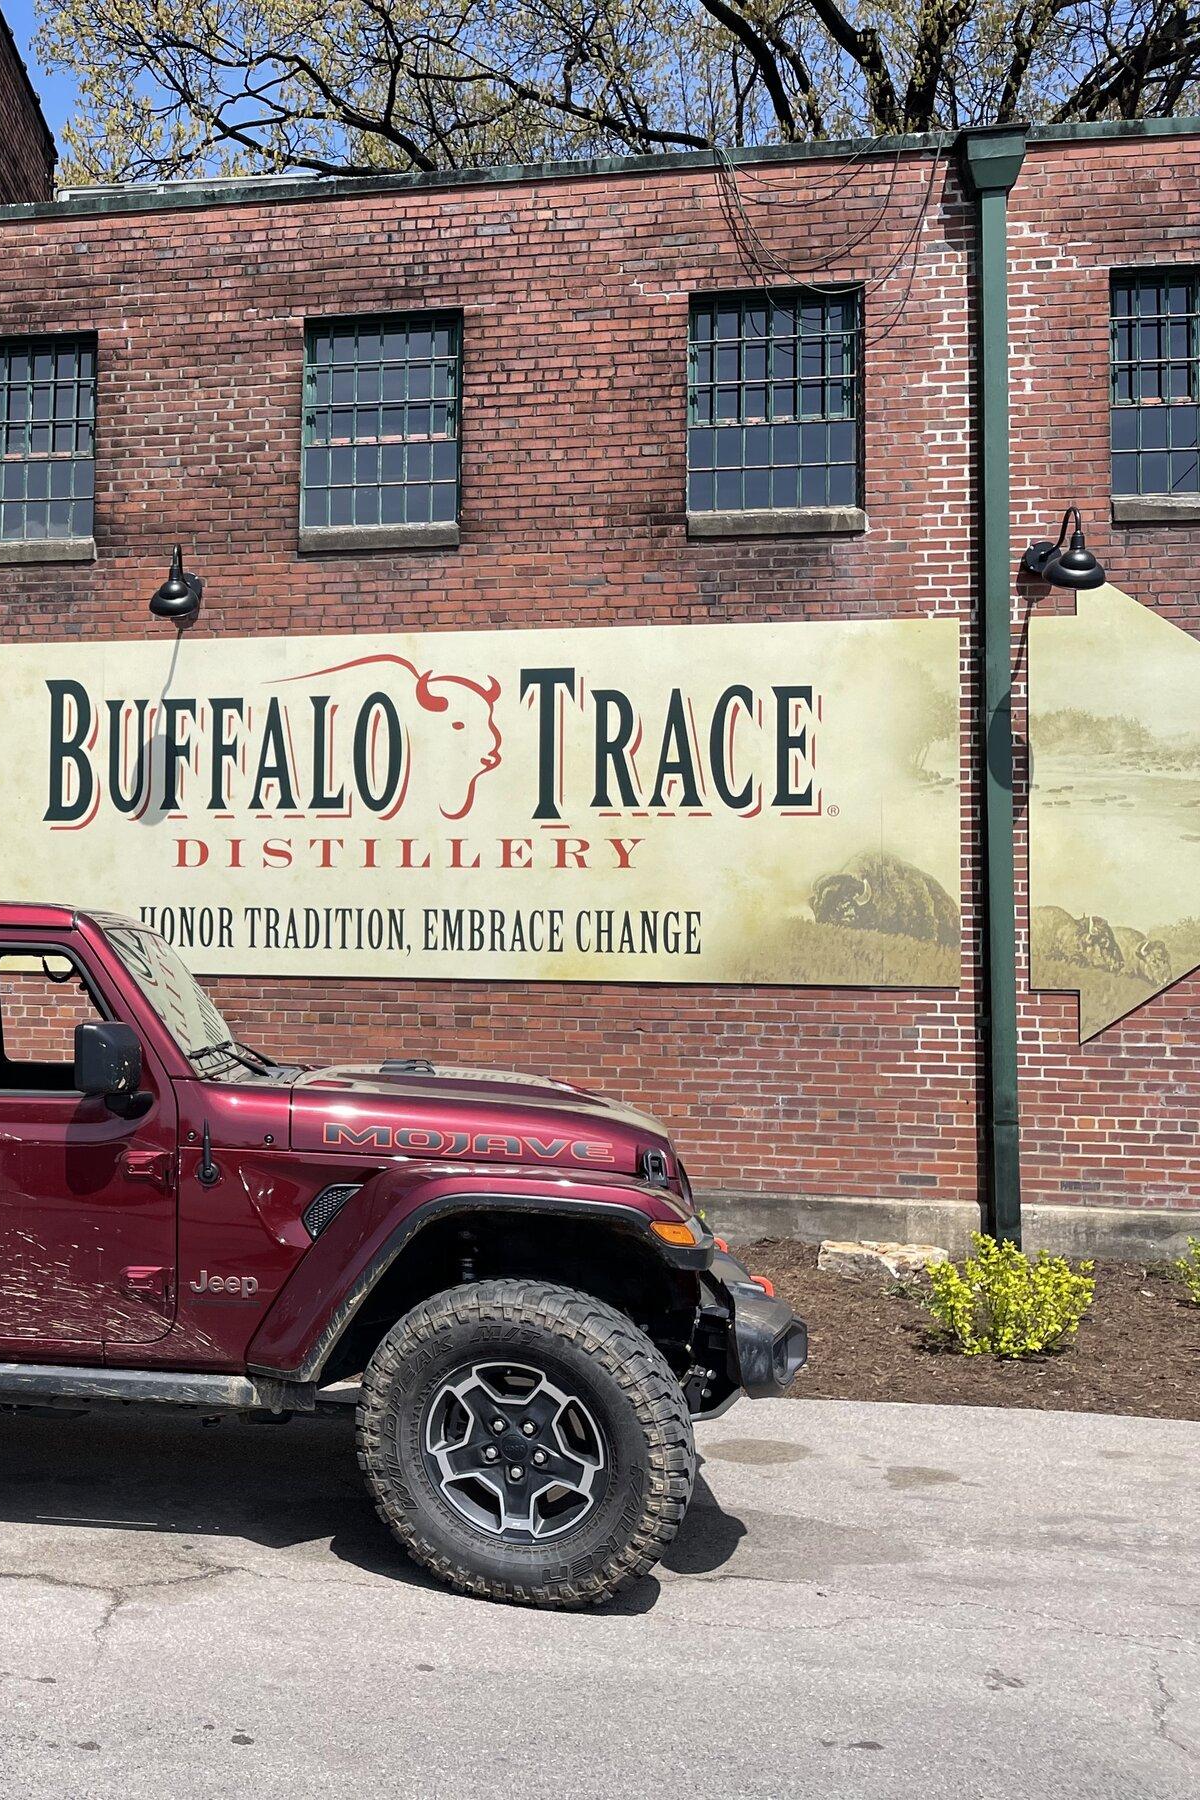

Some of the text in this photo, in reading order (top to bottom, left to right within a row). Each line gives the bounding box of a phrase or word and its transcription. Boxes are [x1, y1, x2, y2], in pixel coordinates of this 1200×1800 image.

[42, 667, 822, 830] BUFFALO TRACE
[171, 837, 646, 869] DISTILLERY
[243, 906, 412, 957] TRADITION,
[421, 907, 564, 952] EMBRACE
[575, 909, 702, 955] CHANGE
[322, 1122, 616, 1163] MOJAVE
[189, 1270, 258, 1298] Jeep
[469, 1324, 543, 1344] M/T
